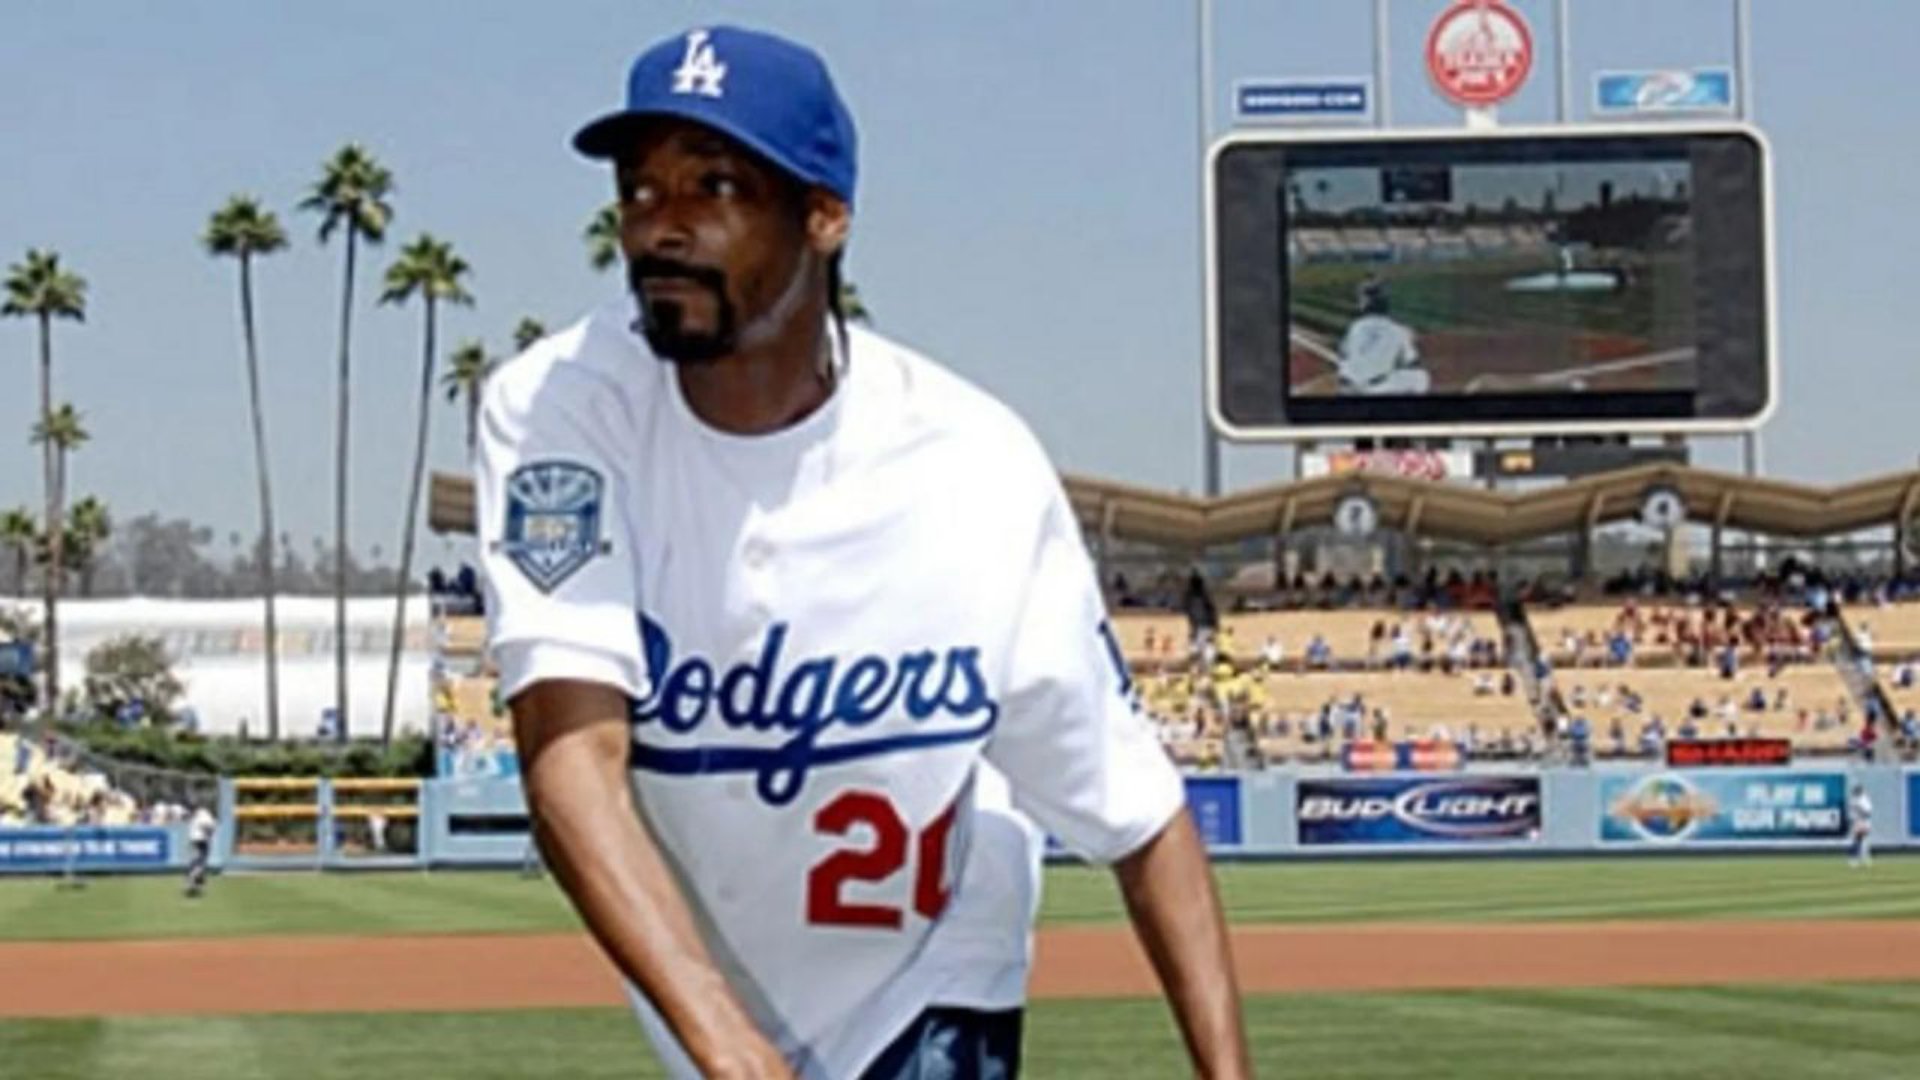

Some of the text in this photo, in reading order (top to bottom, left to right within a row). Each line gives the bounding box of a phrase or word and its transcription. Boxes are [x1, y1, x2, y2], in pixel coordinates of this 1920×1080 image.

[1746, 783, 1798, 805] PLAY
[1299, 793, 1539, 820] BUD LIGHT
[1733, 808, 1775, 830] OUR
